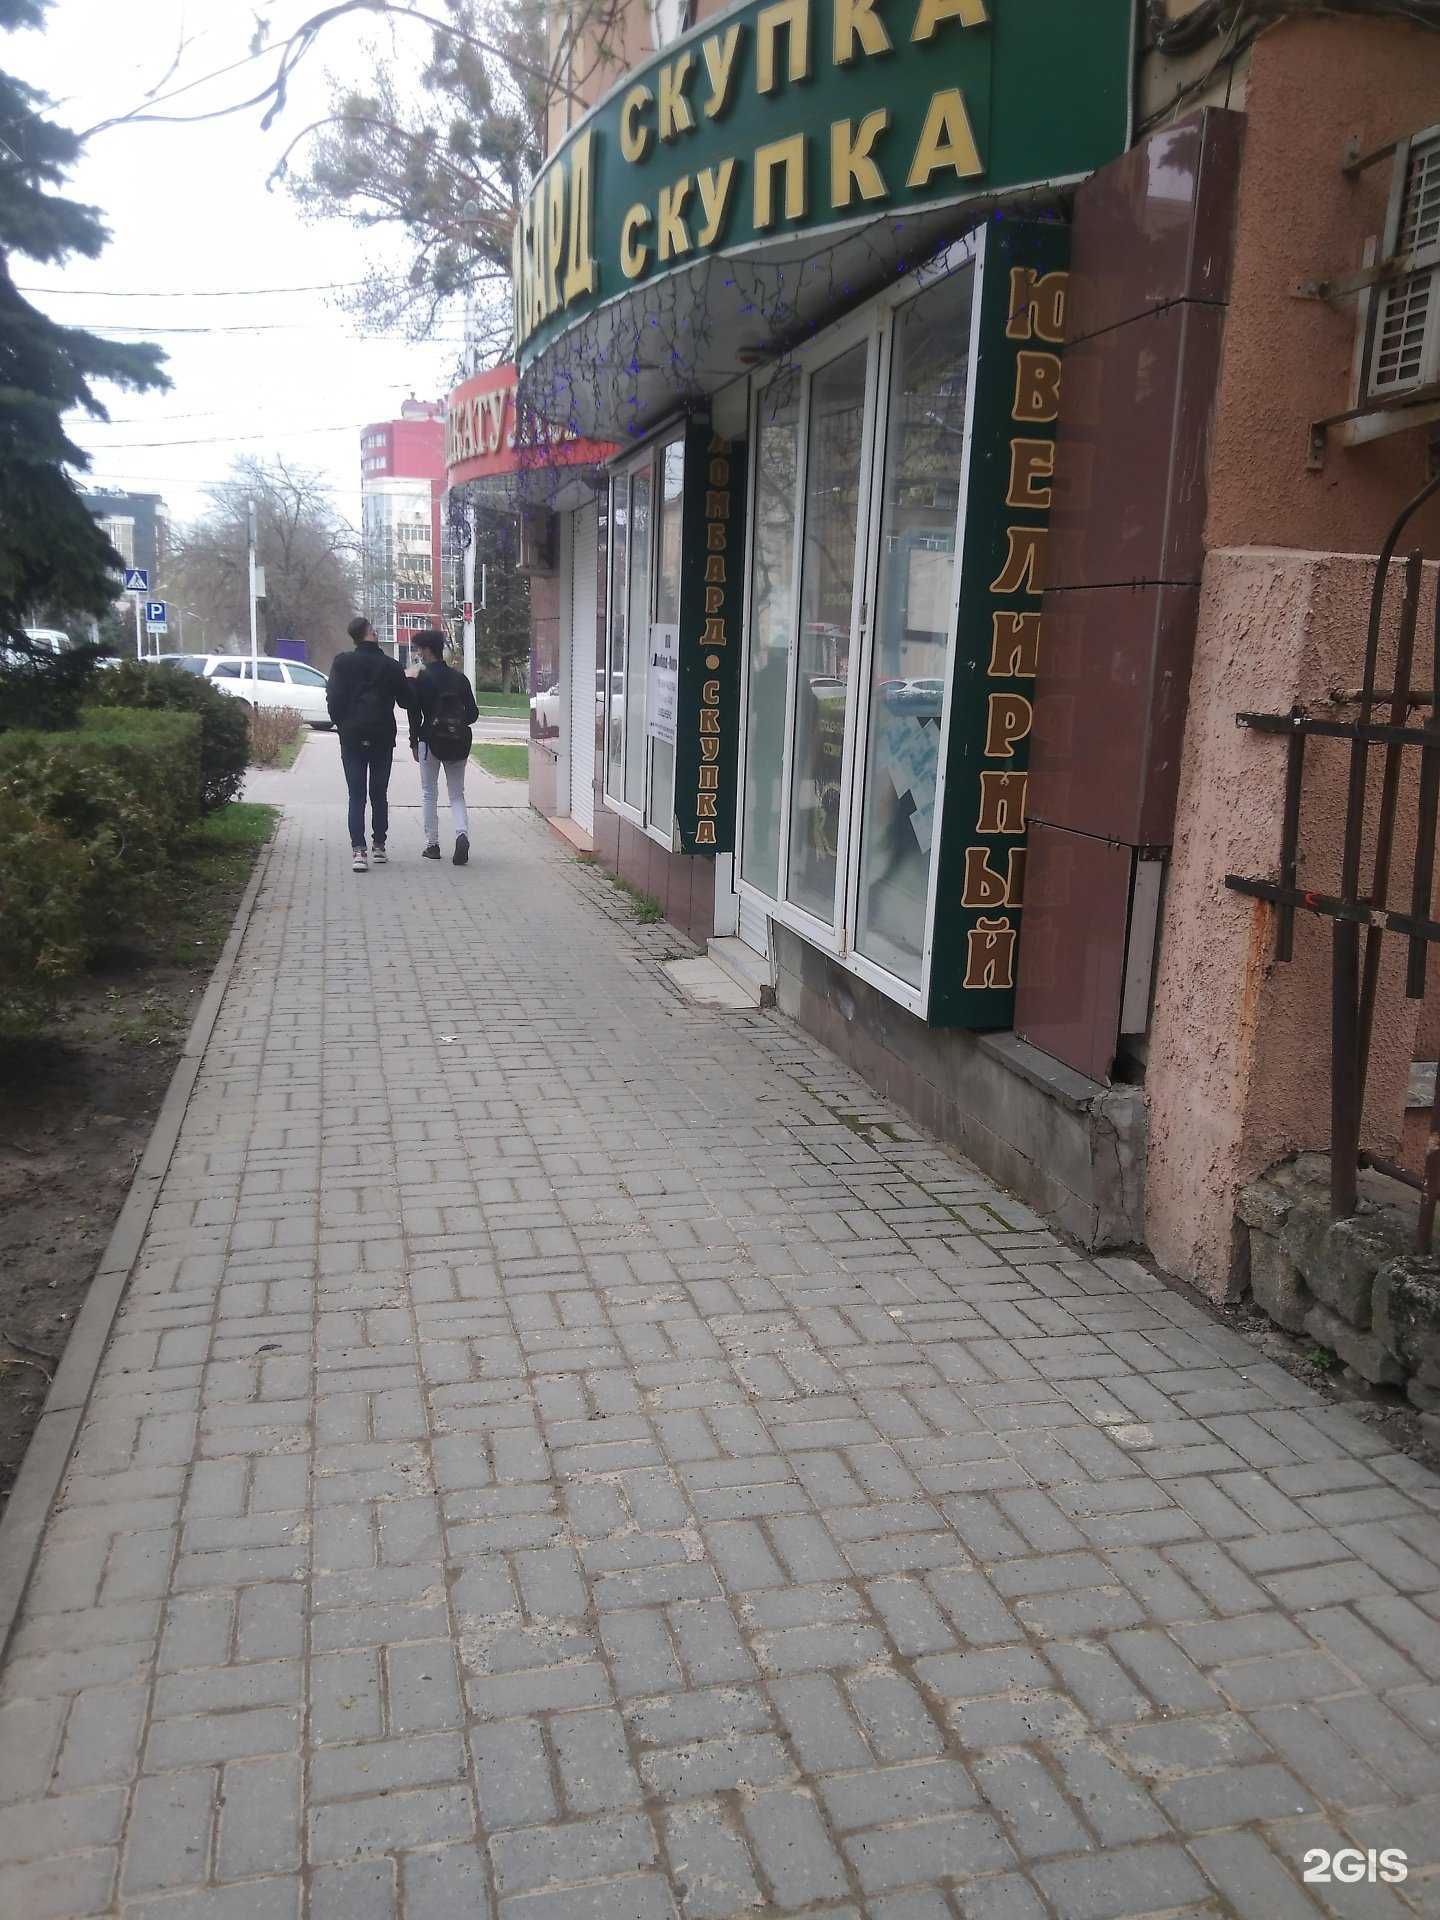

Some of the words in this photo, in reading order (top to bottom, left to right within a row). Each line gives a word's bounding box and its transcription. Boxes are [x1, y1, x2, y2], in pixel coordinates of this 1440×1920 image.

[619, 88, 985, 279] СКУПКА
[151, 604, 162, 620] P
[961, 267, 1069, 989] ЮВЕЛИРНЫЙ
[695, 680, 720, 845] СКУПКА
